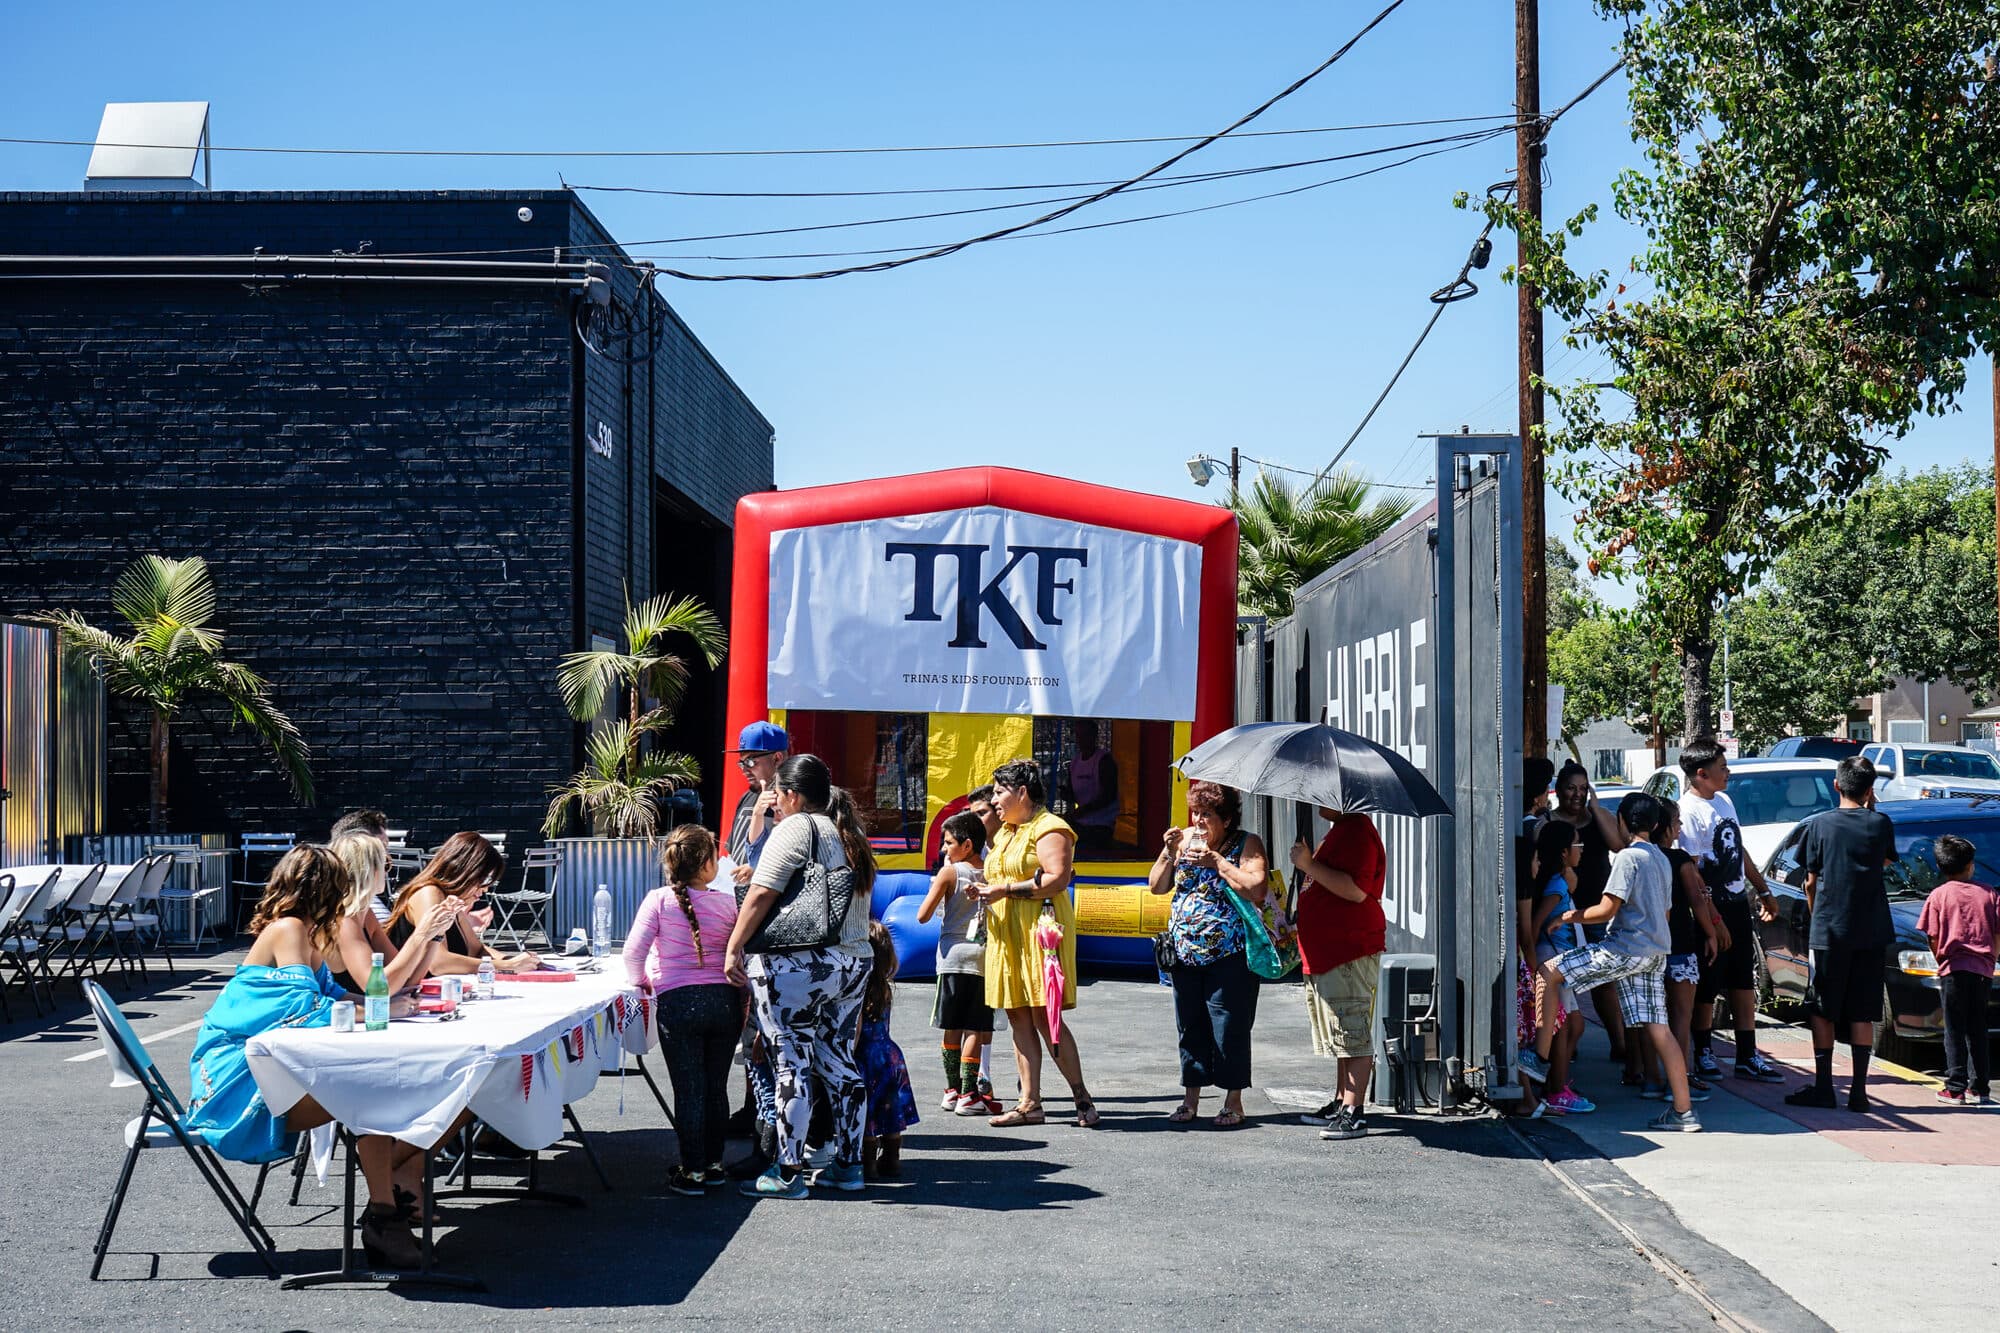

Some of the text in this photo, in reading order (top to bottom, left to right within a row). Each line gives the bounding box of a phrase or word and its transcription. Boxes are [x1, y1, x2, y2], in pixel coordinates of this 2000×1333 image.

[598, 421, 612, 459] 539
[885, 543, 1088, 650] TKF
[903, 673, 1060, 687] TRINA'S KIDS FOUNDATION
[1327, 618, 1427, 769] HUBBLE
